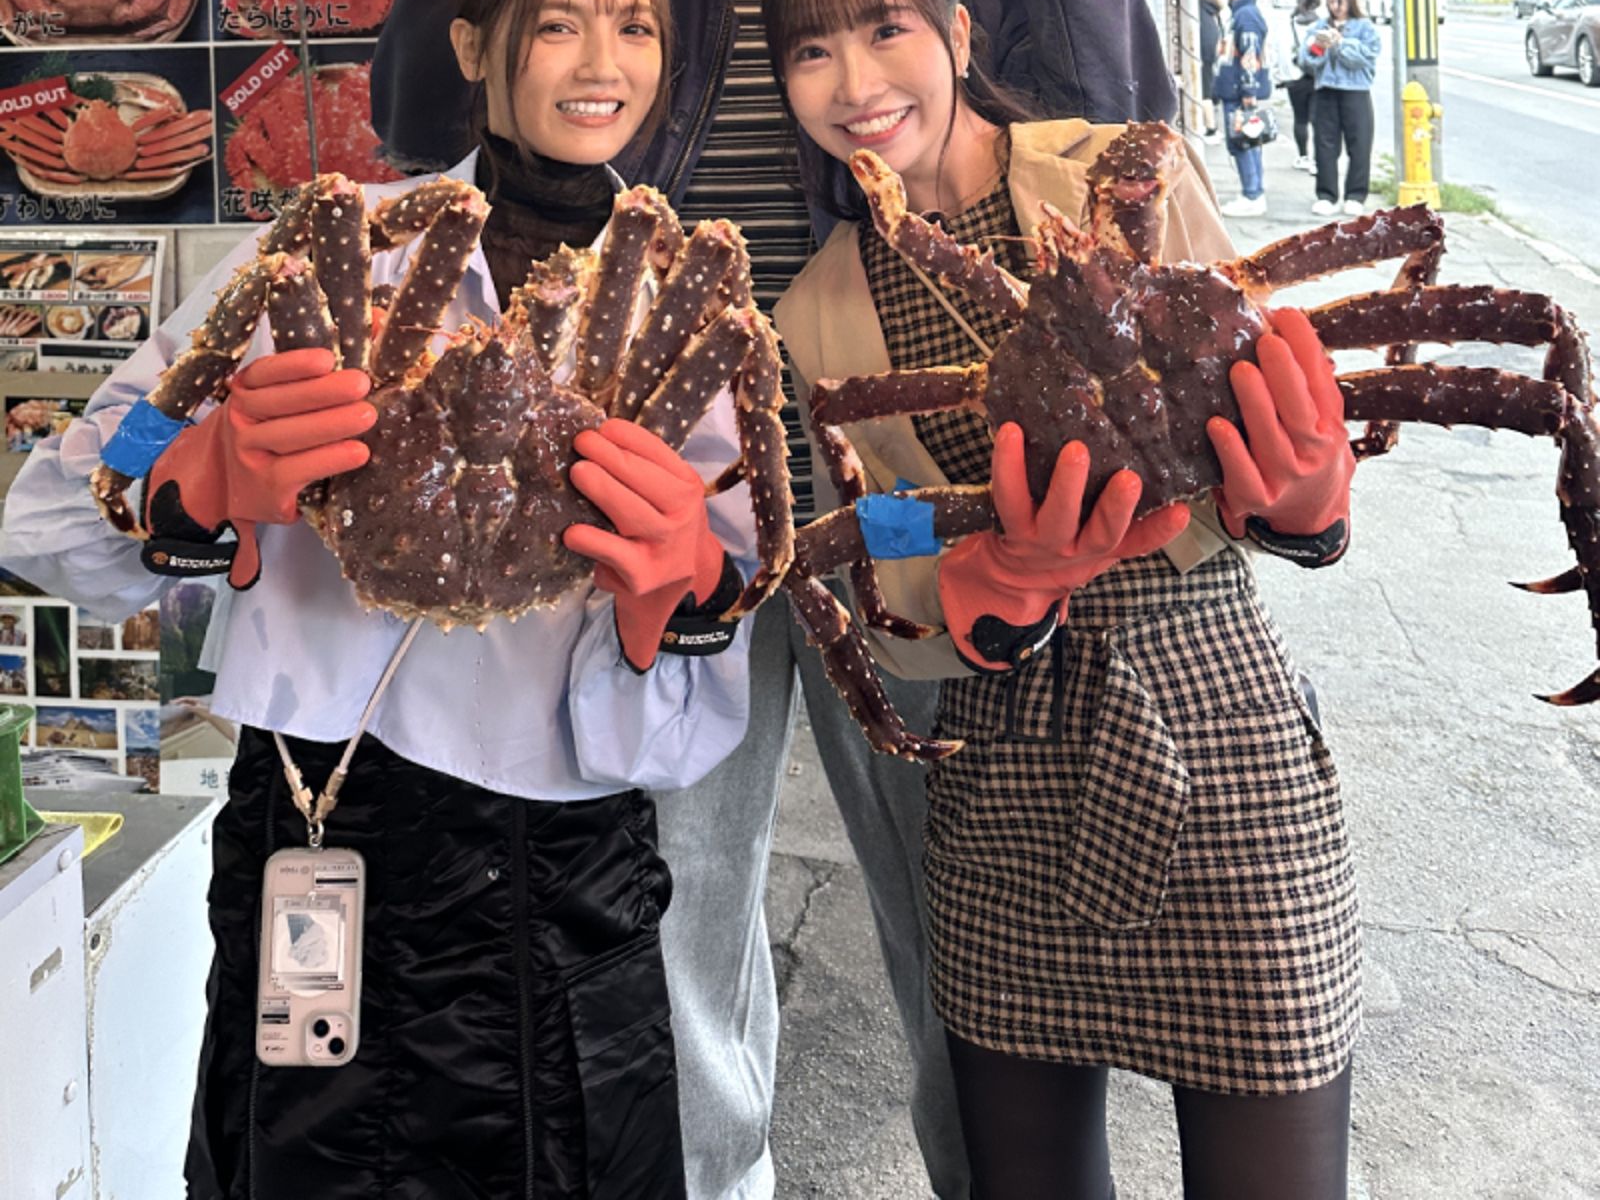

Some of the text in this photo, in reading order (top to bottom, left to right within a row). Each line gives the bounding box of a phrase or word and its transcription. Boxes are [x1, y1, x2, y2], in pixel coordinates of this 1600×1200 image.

[0, 10, 65, 36] がに
[219, 3, 349, 30] たらばがに
[225, 47, 290, 112] SOLD OUT
[34, 86, 67, 105] OUT
